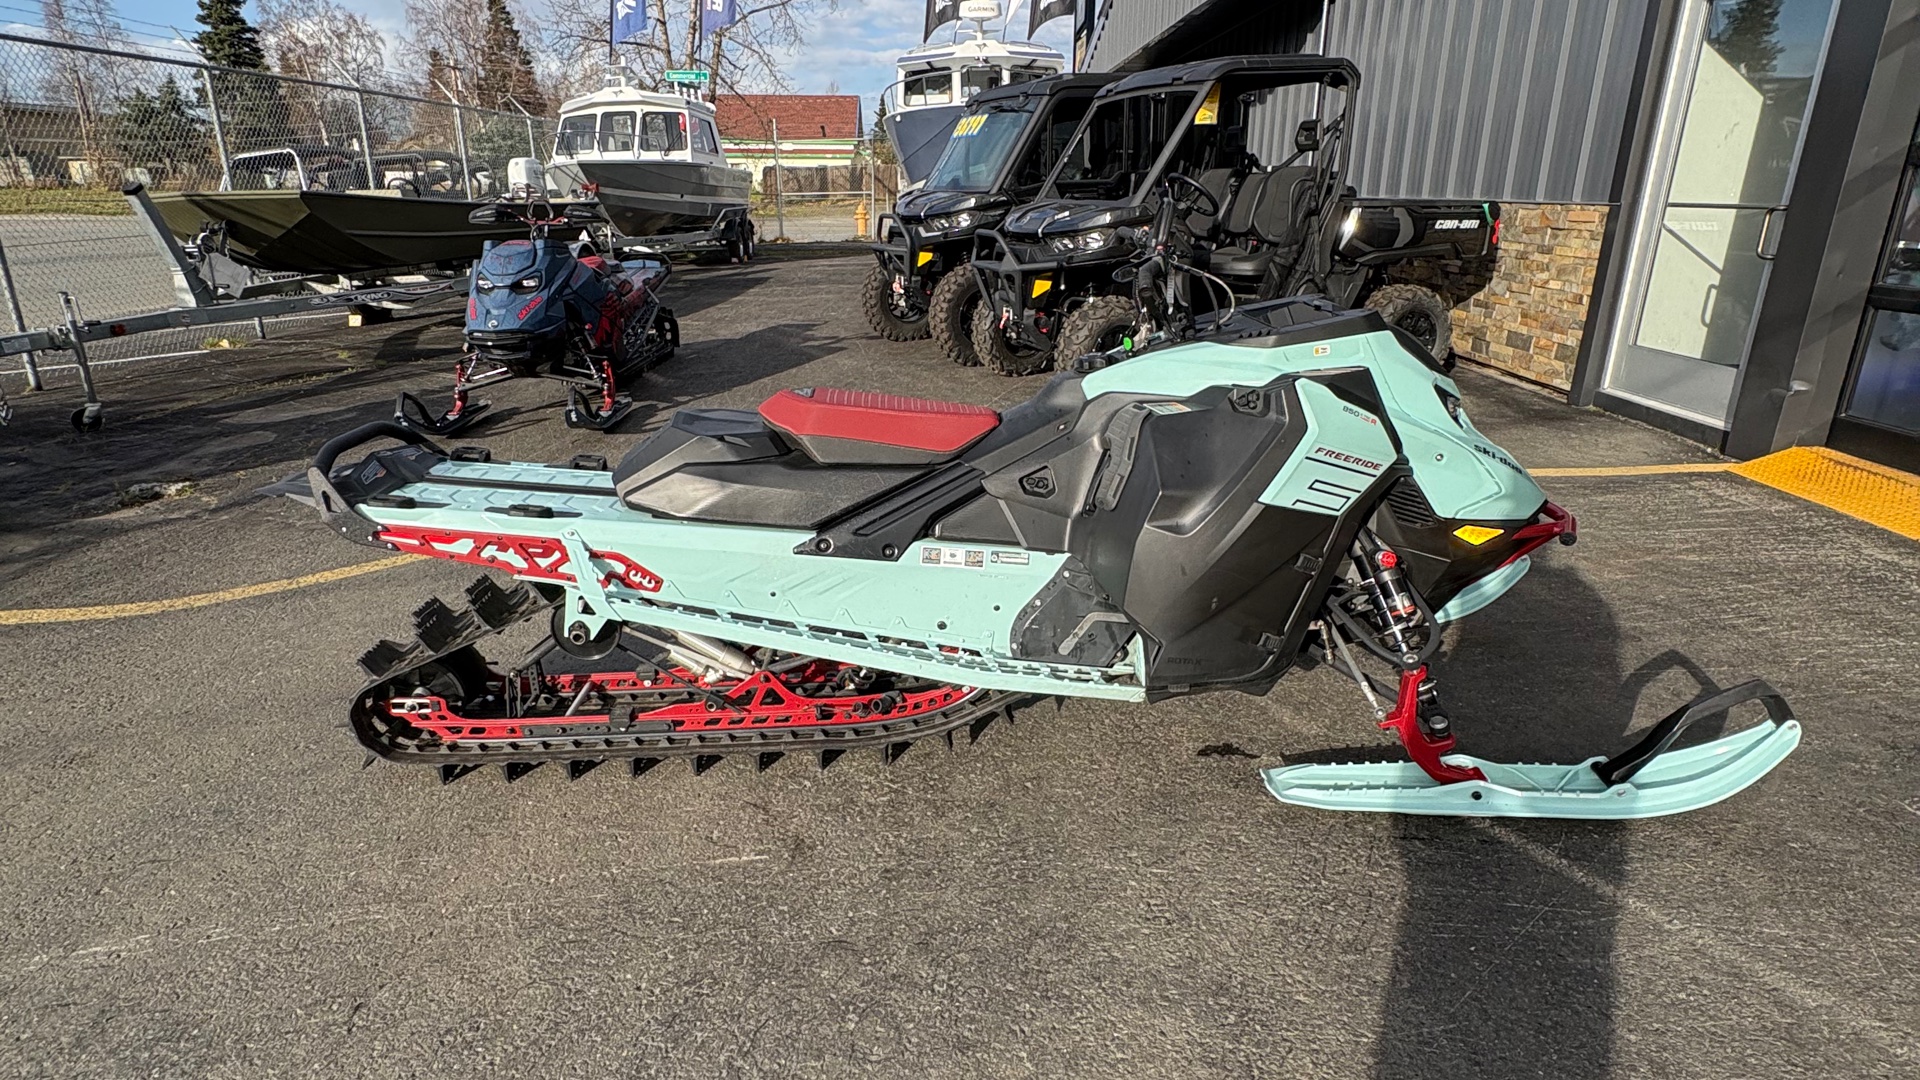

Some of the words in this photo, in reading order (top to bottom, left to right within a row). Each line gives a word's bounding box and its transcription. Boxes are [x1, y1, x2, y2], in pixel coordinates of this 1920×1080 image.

[1434, 219, 1480, 230] can-am
[1342, 405, 1360, 418] 850
[1314, 446, 1384, 472] FREERIDE
